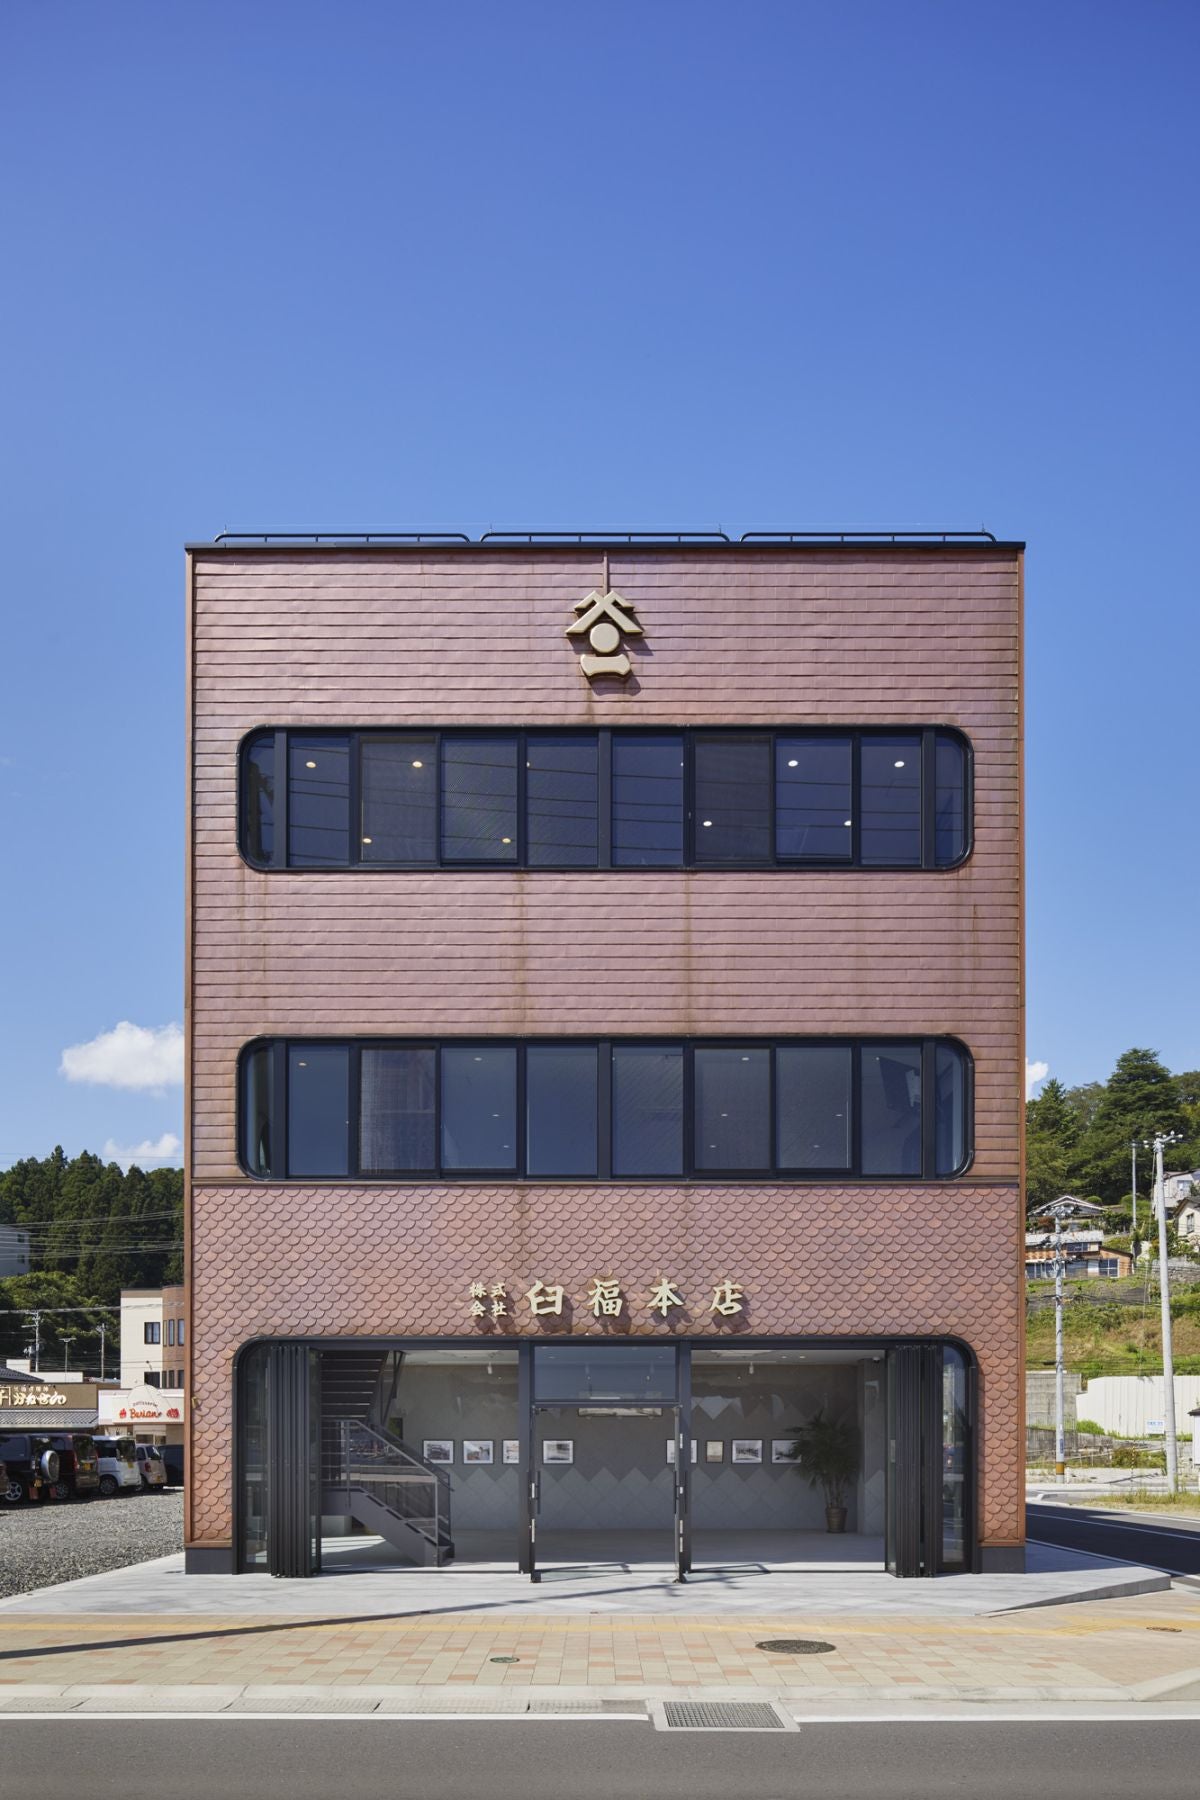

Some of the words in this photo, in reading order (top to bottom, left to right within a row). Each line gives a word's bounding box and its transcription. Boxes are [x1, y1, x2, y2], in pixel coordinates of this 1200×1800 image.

[468, 1281, 507, 1299] 株式
[525, 1278, 744, 1317] 臼福本店
[468, 1300, 508, 1317] 会社
